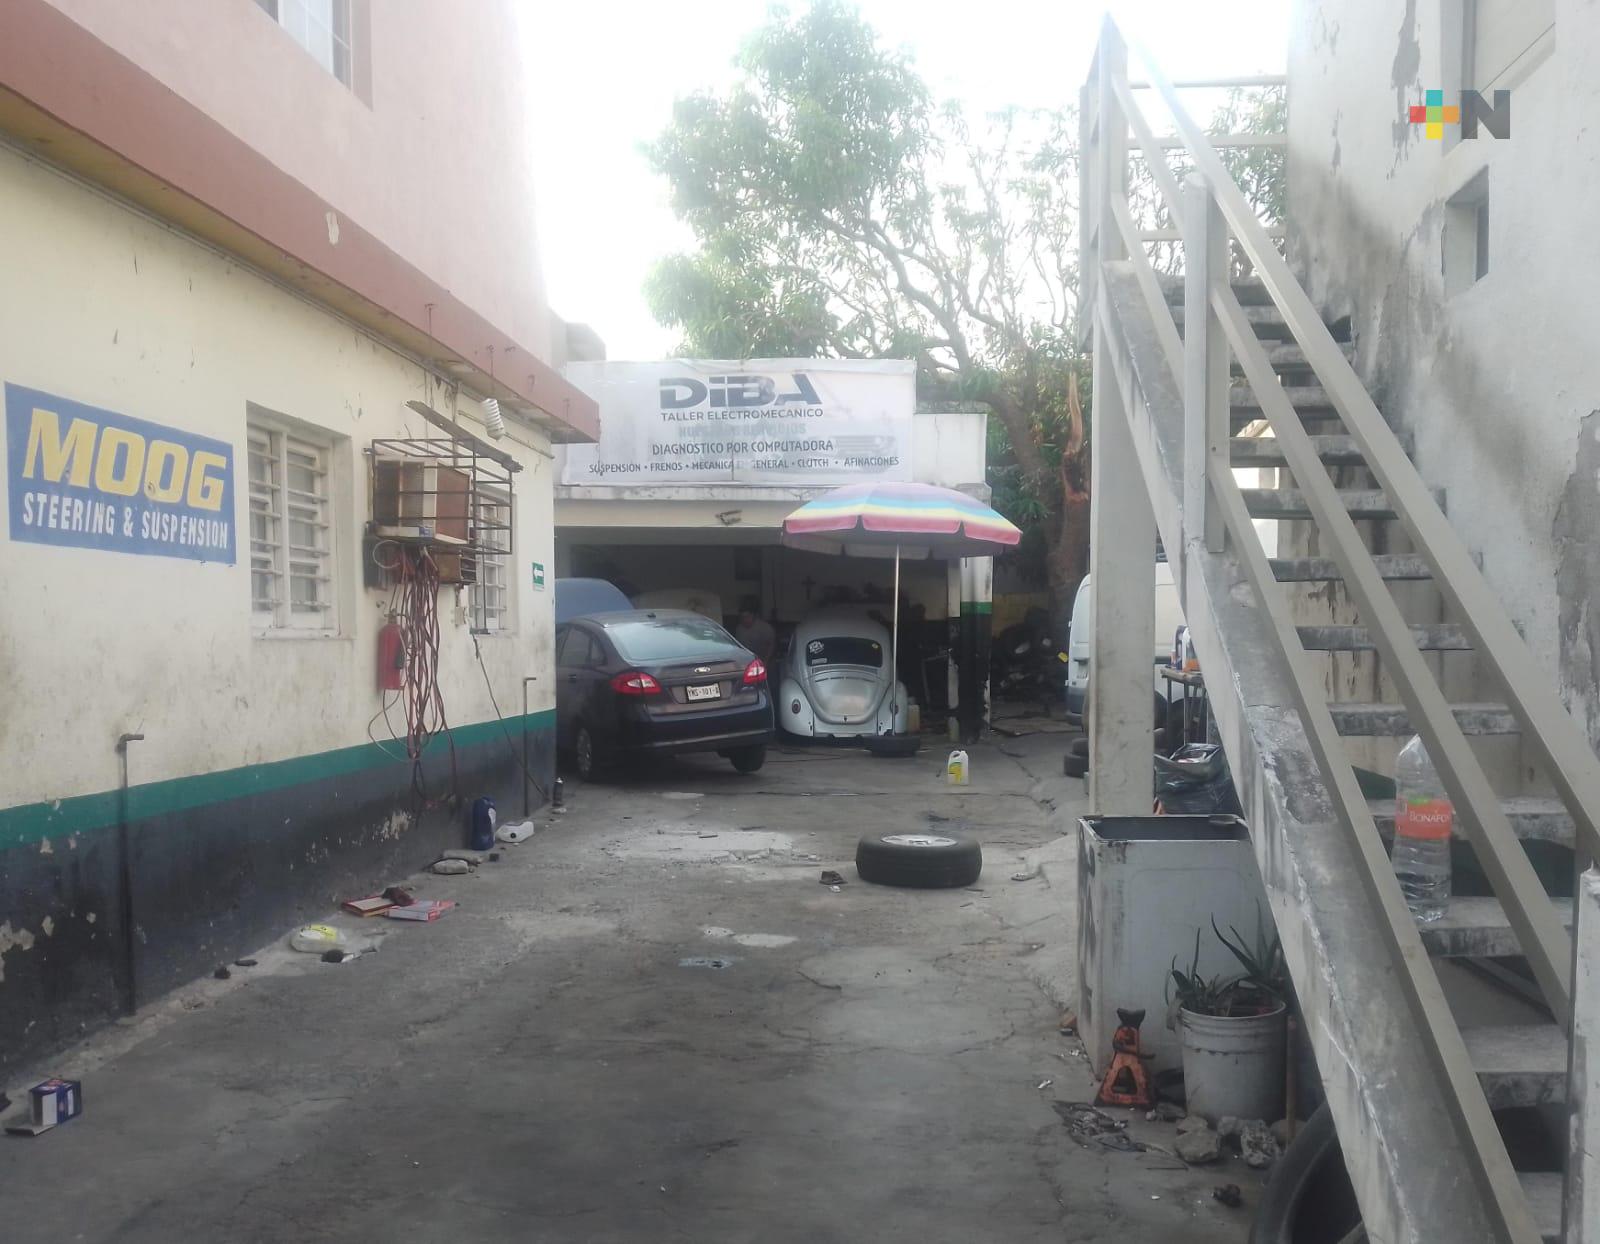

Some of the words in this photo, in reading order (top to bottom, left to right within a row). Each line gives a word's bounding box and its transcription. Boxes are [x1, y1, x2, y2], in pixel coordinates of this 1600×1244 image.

[660, 411, 704, 421] TALLER
[707, 409, 823, 420] ELECTROMECANICO
[727, 441, 748, 453] POR
[751, 440, 833, 452] COMPUTADORA
[22, 407, 227, 511] MOOG
[589, 463, 641, 473] SUSPENSION
[650, 462, 683, 472] FRENOS
[691, 460, 735, 471] MECANICA
[797, 457, 829, 468] CLUTCH
[844, 456, 899, 467] AFINACIONES
[23, 492, 115, 535] STEERING
[123, 506, 134, 537] &
[141, 510, 228, 549] SUSPENSION
